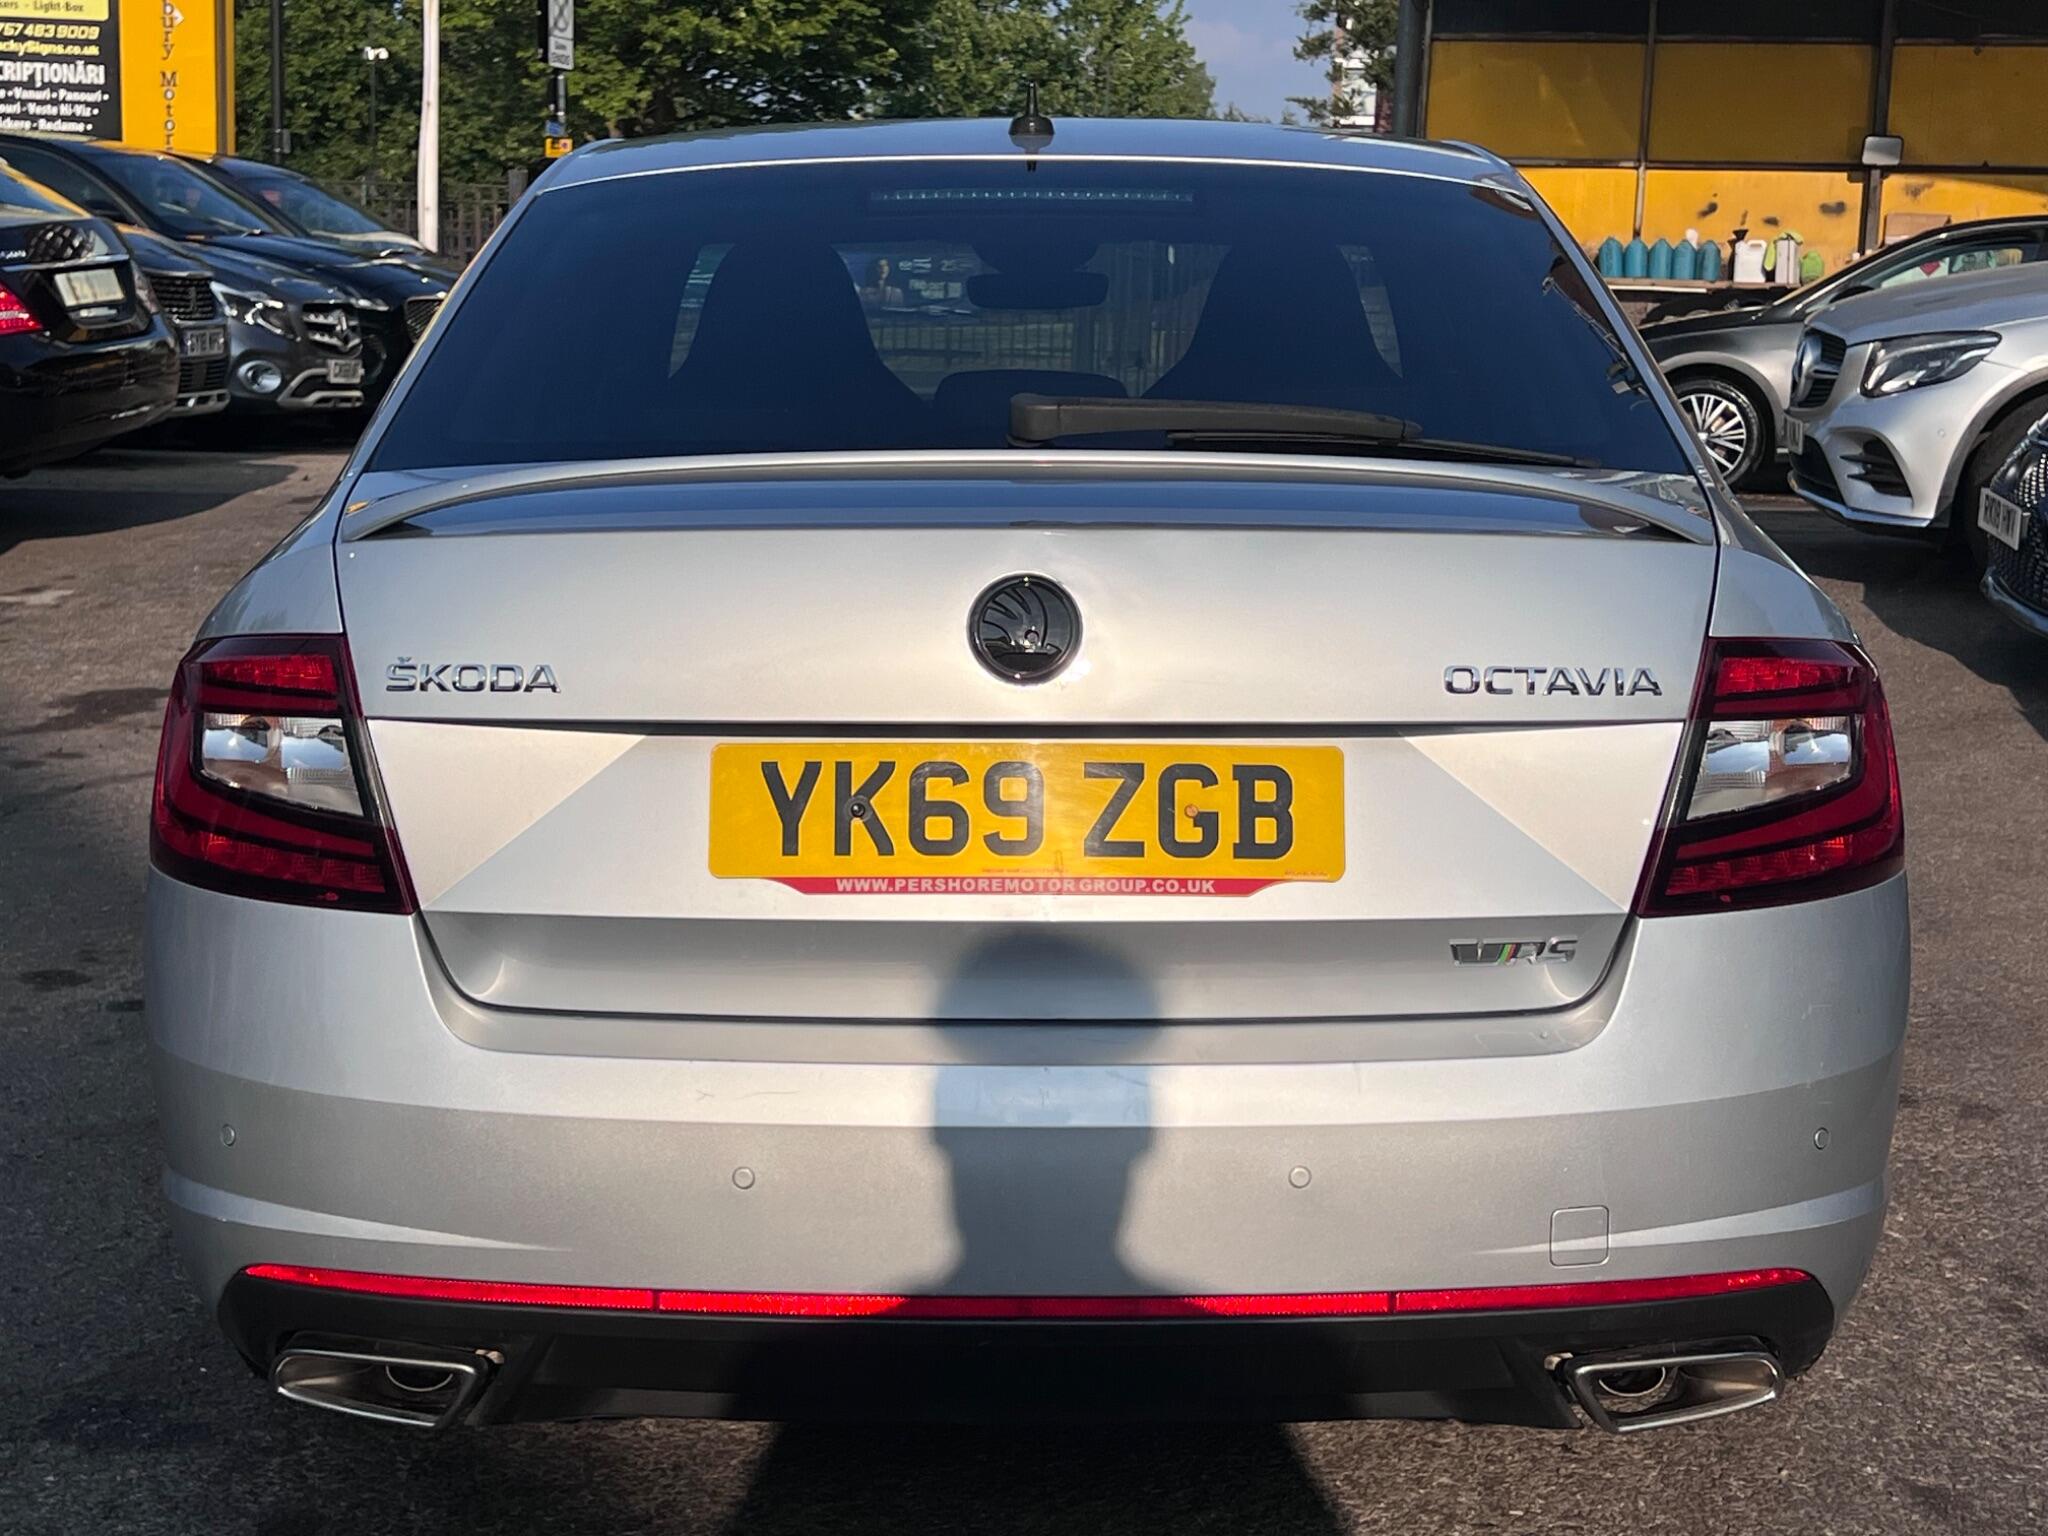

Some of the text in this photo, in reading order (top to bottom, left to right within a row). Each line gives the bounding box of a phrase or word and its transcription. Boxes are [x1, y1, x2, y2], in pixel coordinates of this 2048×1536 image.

[386, 656, 560, 693] ŠKODA
[1444, 665, 1662, 696] OCTAVIA
[761, 761, 1294, 860] YK69 ZGB
